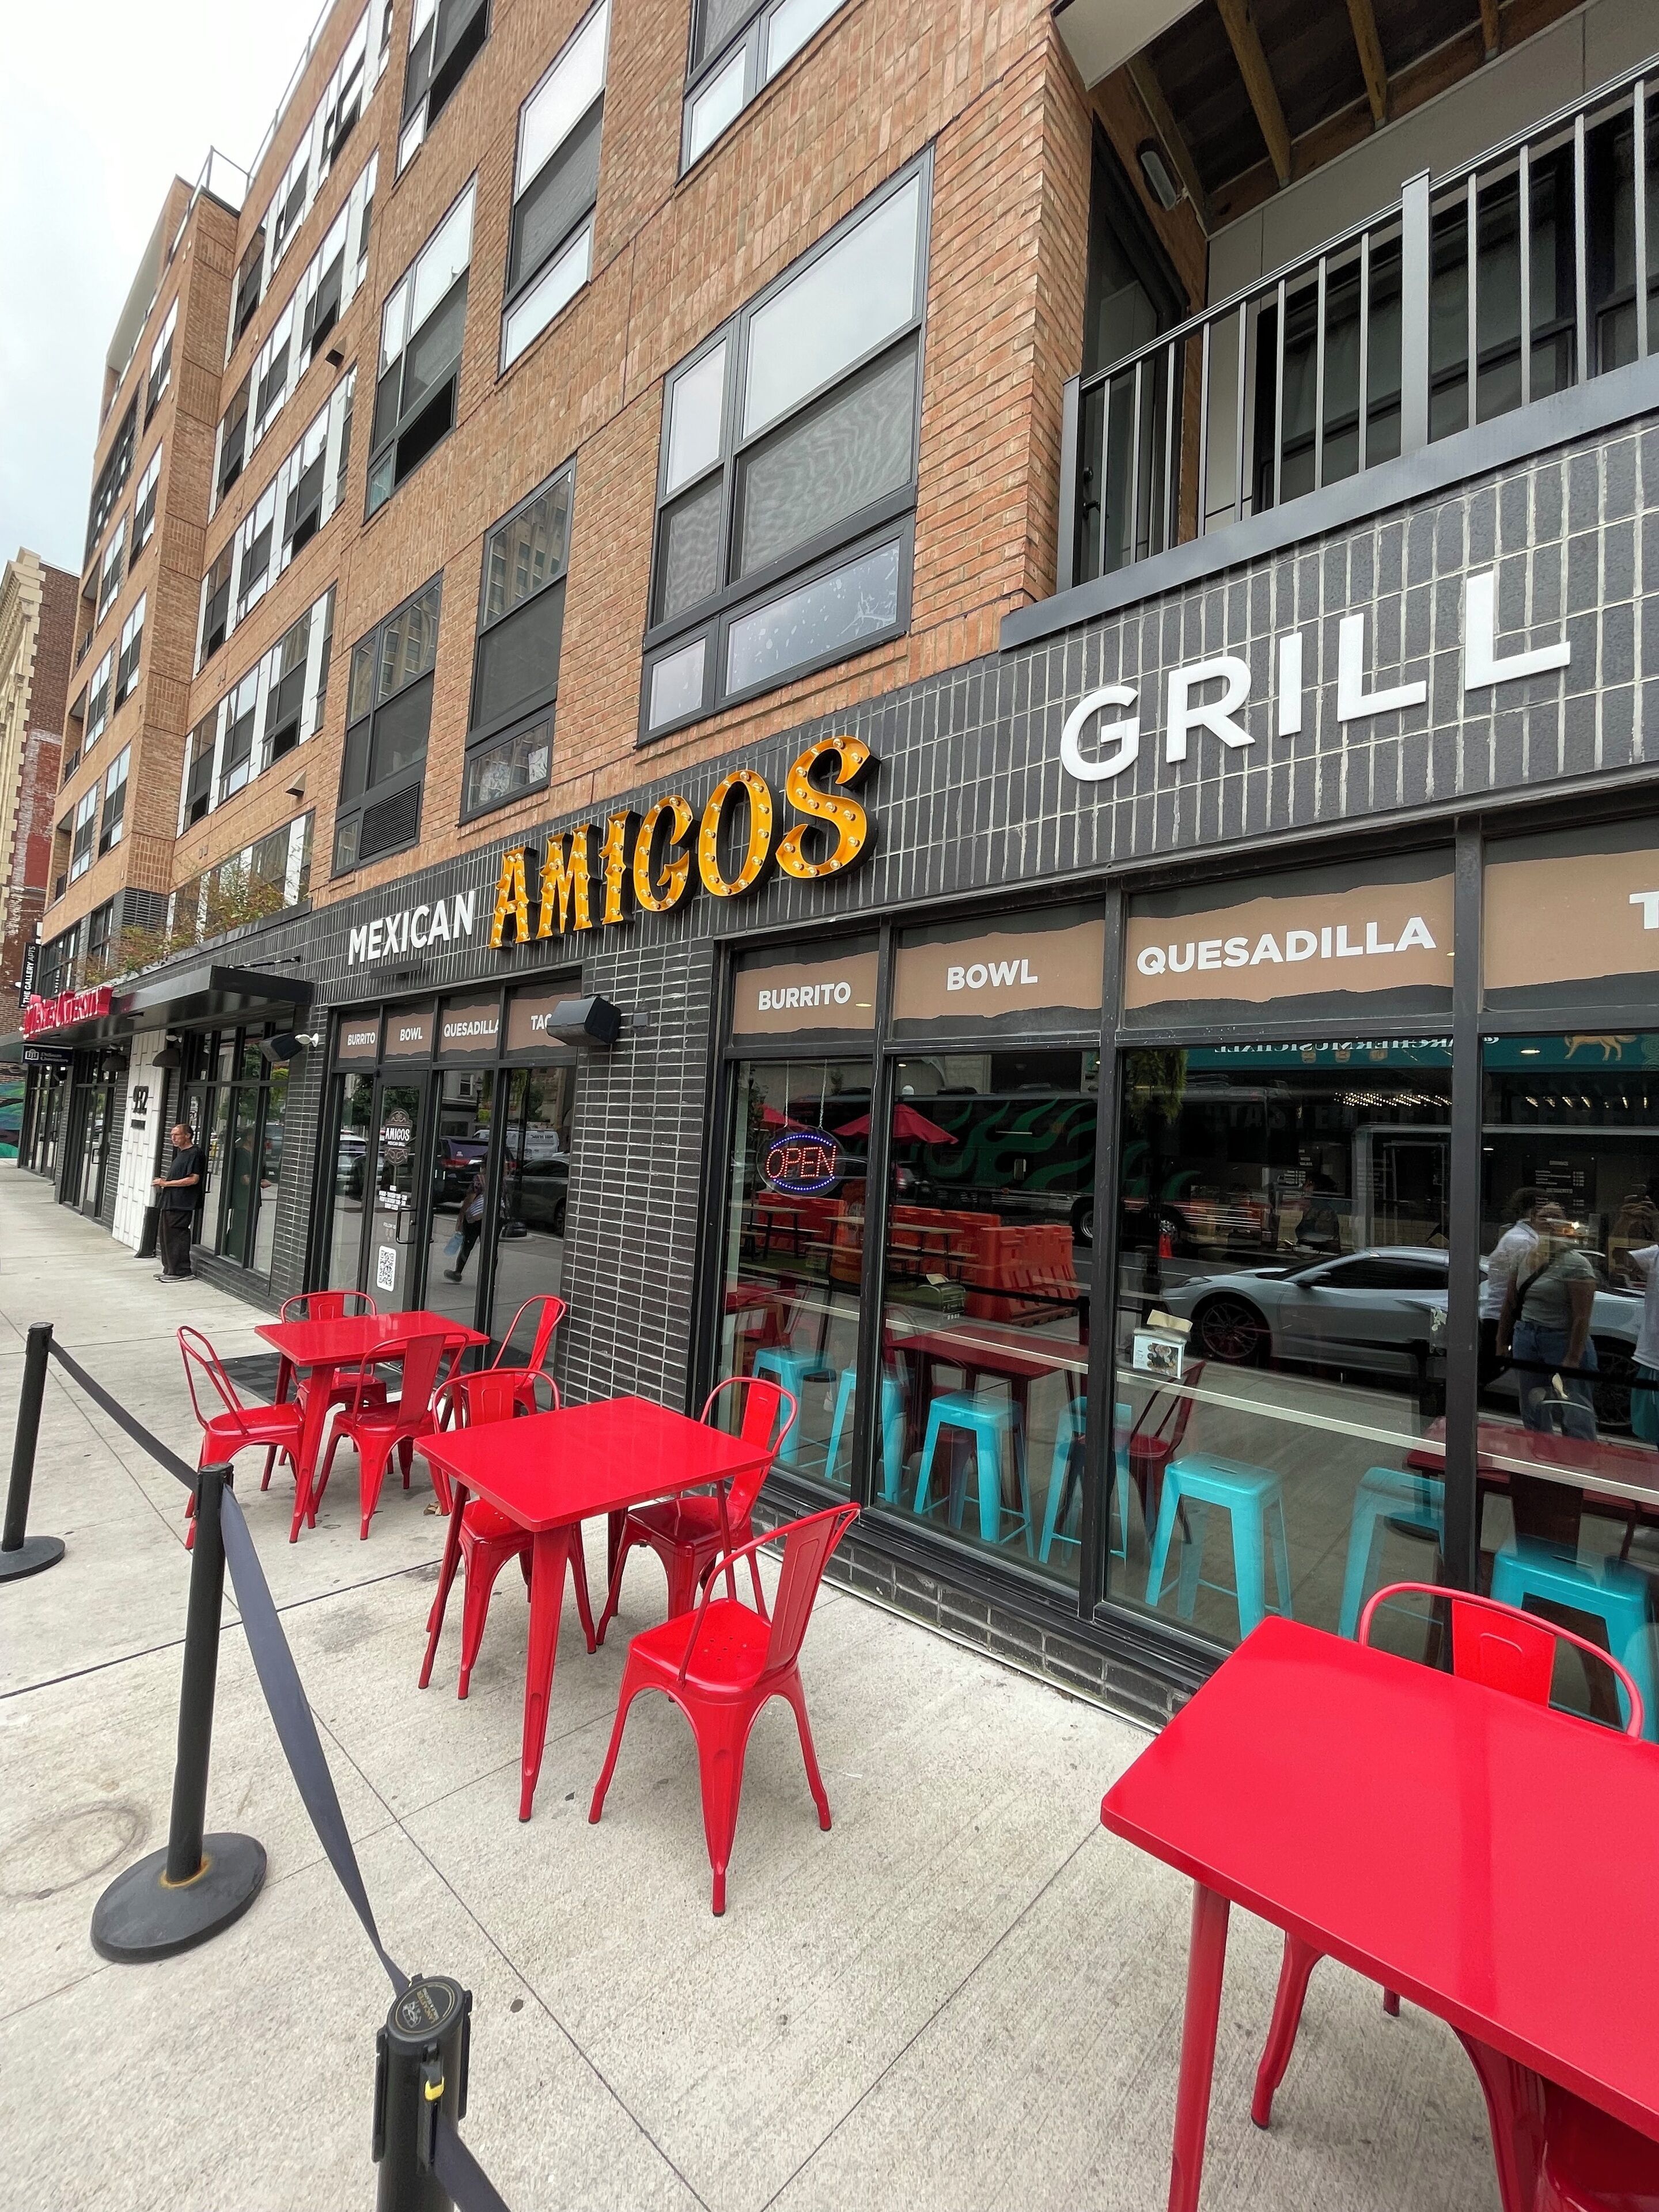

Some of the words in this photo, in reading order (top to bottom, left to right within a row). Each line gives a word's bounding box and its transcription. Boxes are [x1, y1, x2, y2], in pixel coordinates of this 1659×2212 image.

[1060, 570, 1571, 782] GRILL
[488, 736, 871, 949] AMIGOS
[348, 890, 475, 965] MEXICAN
[28, 946, 36, 961] APTS
[1137, 916, 1437, 975] QUESADILLA
[24, 961, 35, 990] GALLERY
[946, 959, 1038, 991] BOWL
[22, 991, 31, 1003] THE
[758, 982, 851, 1011] BURRITO
[400, 1027, 423, 1041] BOWL
[444, 1018, 499, 1037] QUESADILLA
[531, 1014, 552, 1031] TAC
[347, 1032, 376, 1046] BURRITO
[385, 1127, 410, 1142] AMIGOS
[766, 1146, 837, 1178] OPEN
